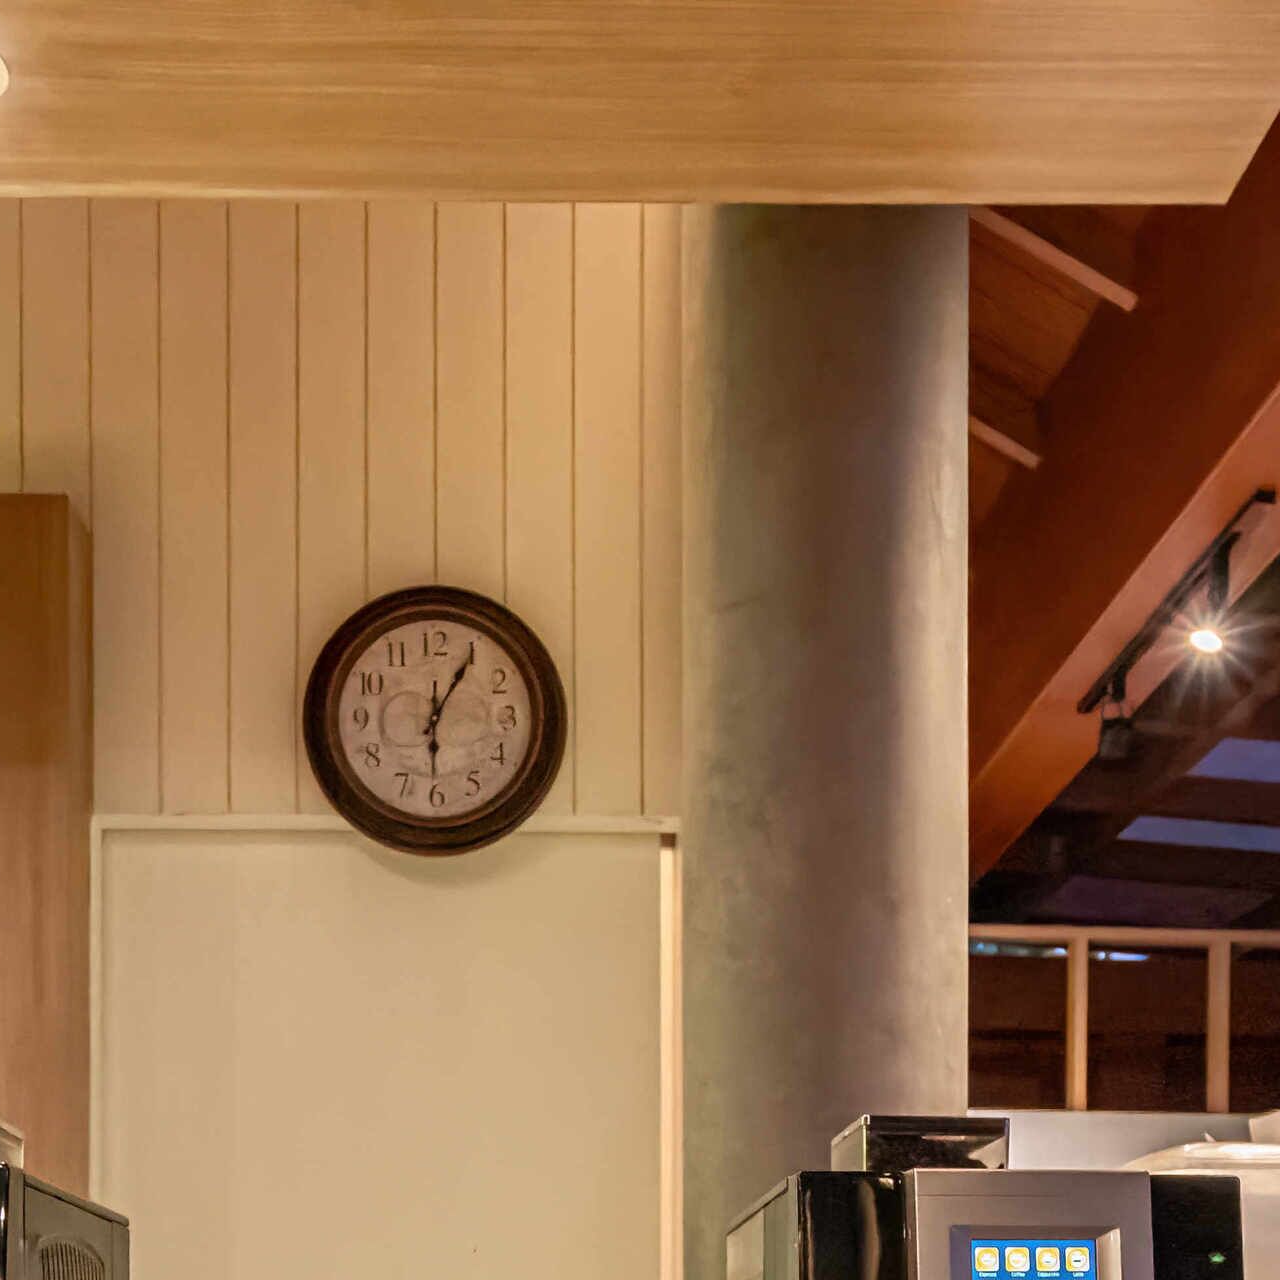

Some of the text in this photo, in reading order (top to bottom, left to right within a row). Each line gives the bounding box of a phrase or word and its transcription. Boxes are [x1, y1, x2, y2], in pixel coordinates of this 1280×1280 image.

[387, 641, 406, 667] 11
[422, 631, 448, 656] 12
[360, 671, 384, 696] 10
[492, 668, 507, 694] 2
[353, 706, 369, 730] 9
[497, 705, 517, 731] 3
[364, 743, 380, 768] 8
[490, 742, 507, 766] 4
[394, 772, 409, 798] 7
[429, 783, 445, 807] 6
[465, 771, 481, 796] 5
